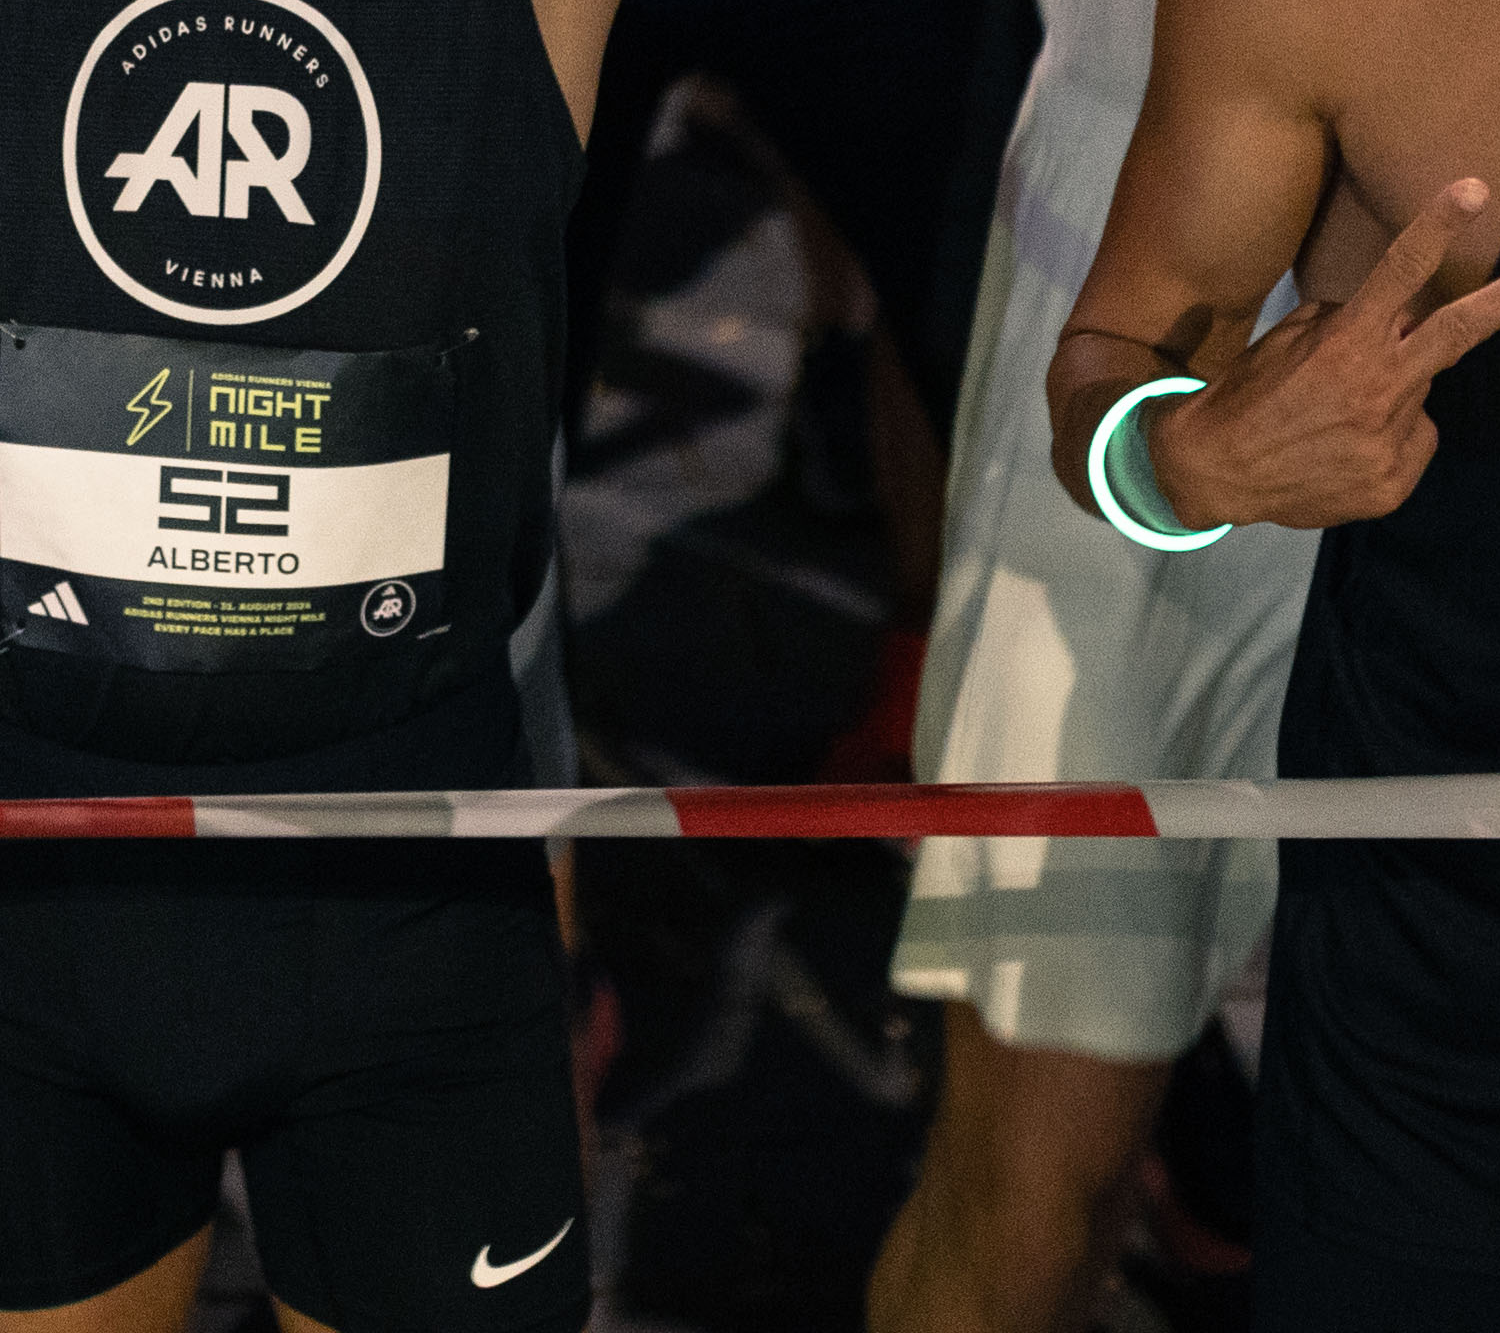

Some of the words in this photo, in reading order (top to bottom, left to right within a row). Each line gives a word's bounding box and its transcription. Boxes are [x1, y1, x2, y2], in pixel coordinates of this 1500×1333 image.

[122, 16, 207, 75] ADIDAS
[224, 16, 329, 88] RUNNERS
[104, 82, 316, 226] AR
[165, 259, 263, 289] VIENNA
[210, 386, 330, 420] NIGHT
[210, 420, 322, 452] MILE
[158, 466, 290, 536] 52
[148, 546, 300, 574] ALBERTO
